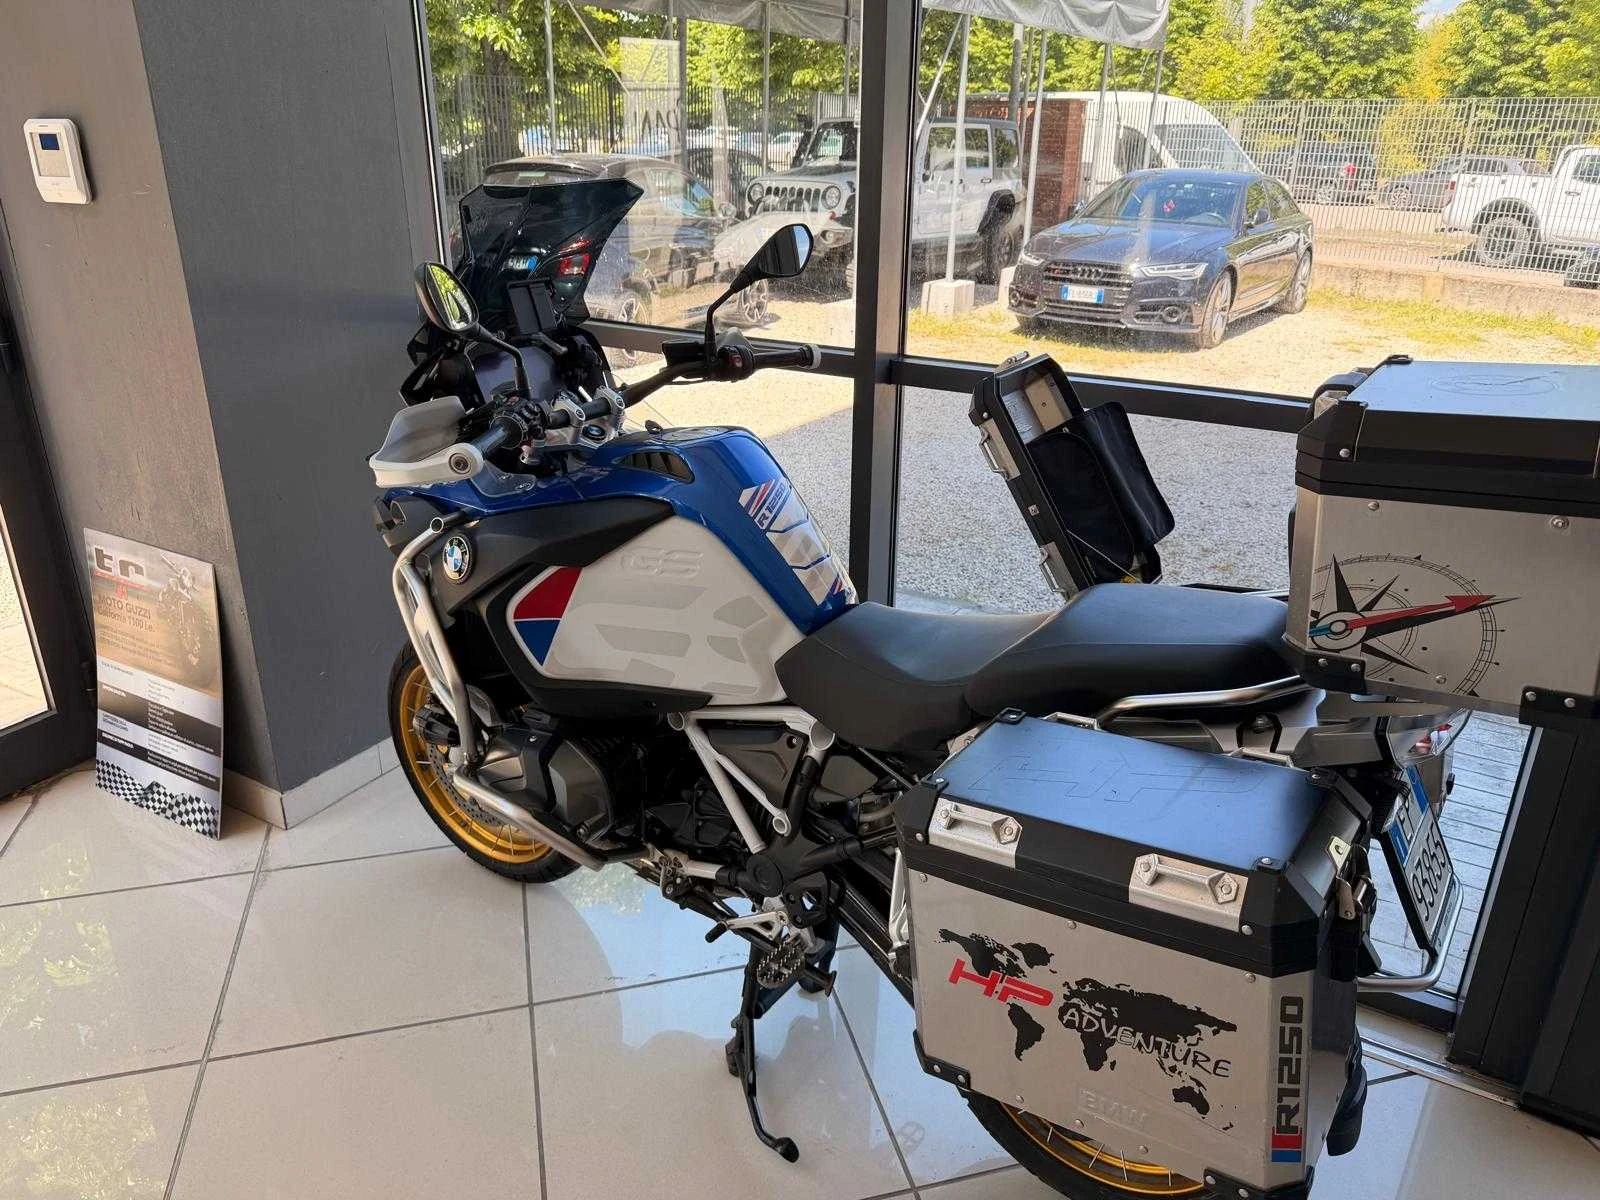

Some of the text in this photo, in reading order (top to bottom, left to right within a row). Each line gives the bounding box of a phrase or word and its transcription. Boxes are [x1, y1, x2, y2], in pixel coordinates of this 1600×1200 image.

[756, 481, 787, 529] R1250
[620, 545, 704, 579] GS
[1412, 821, 1447, 922] 93855
[948, 958, 1054, 1007] HP
[1062, 1007, 1232, 1079] ADVENTURE
[1276, 996, 1304, 1135] R1250
